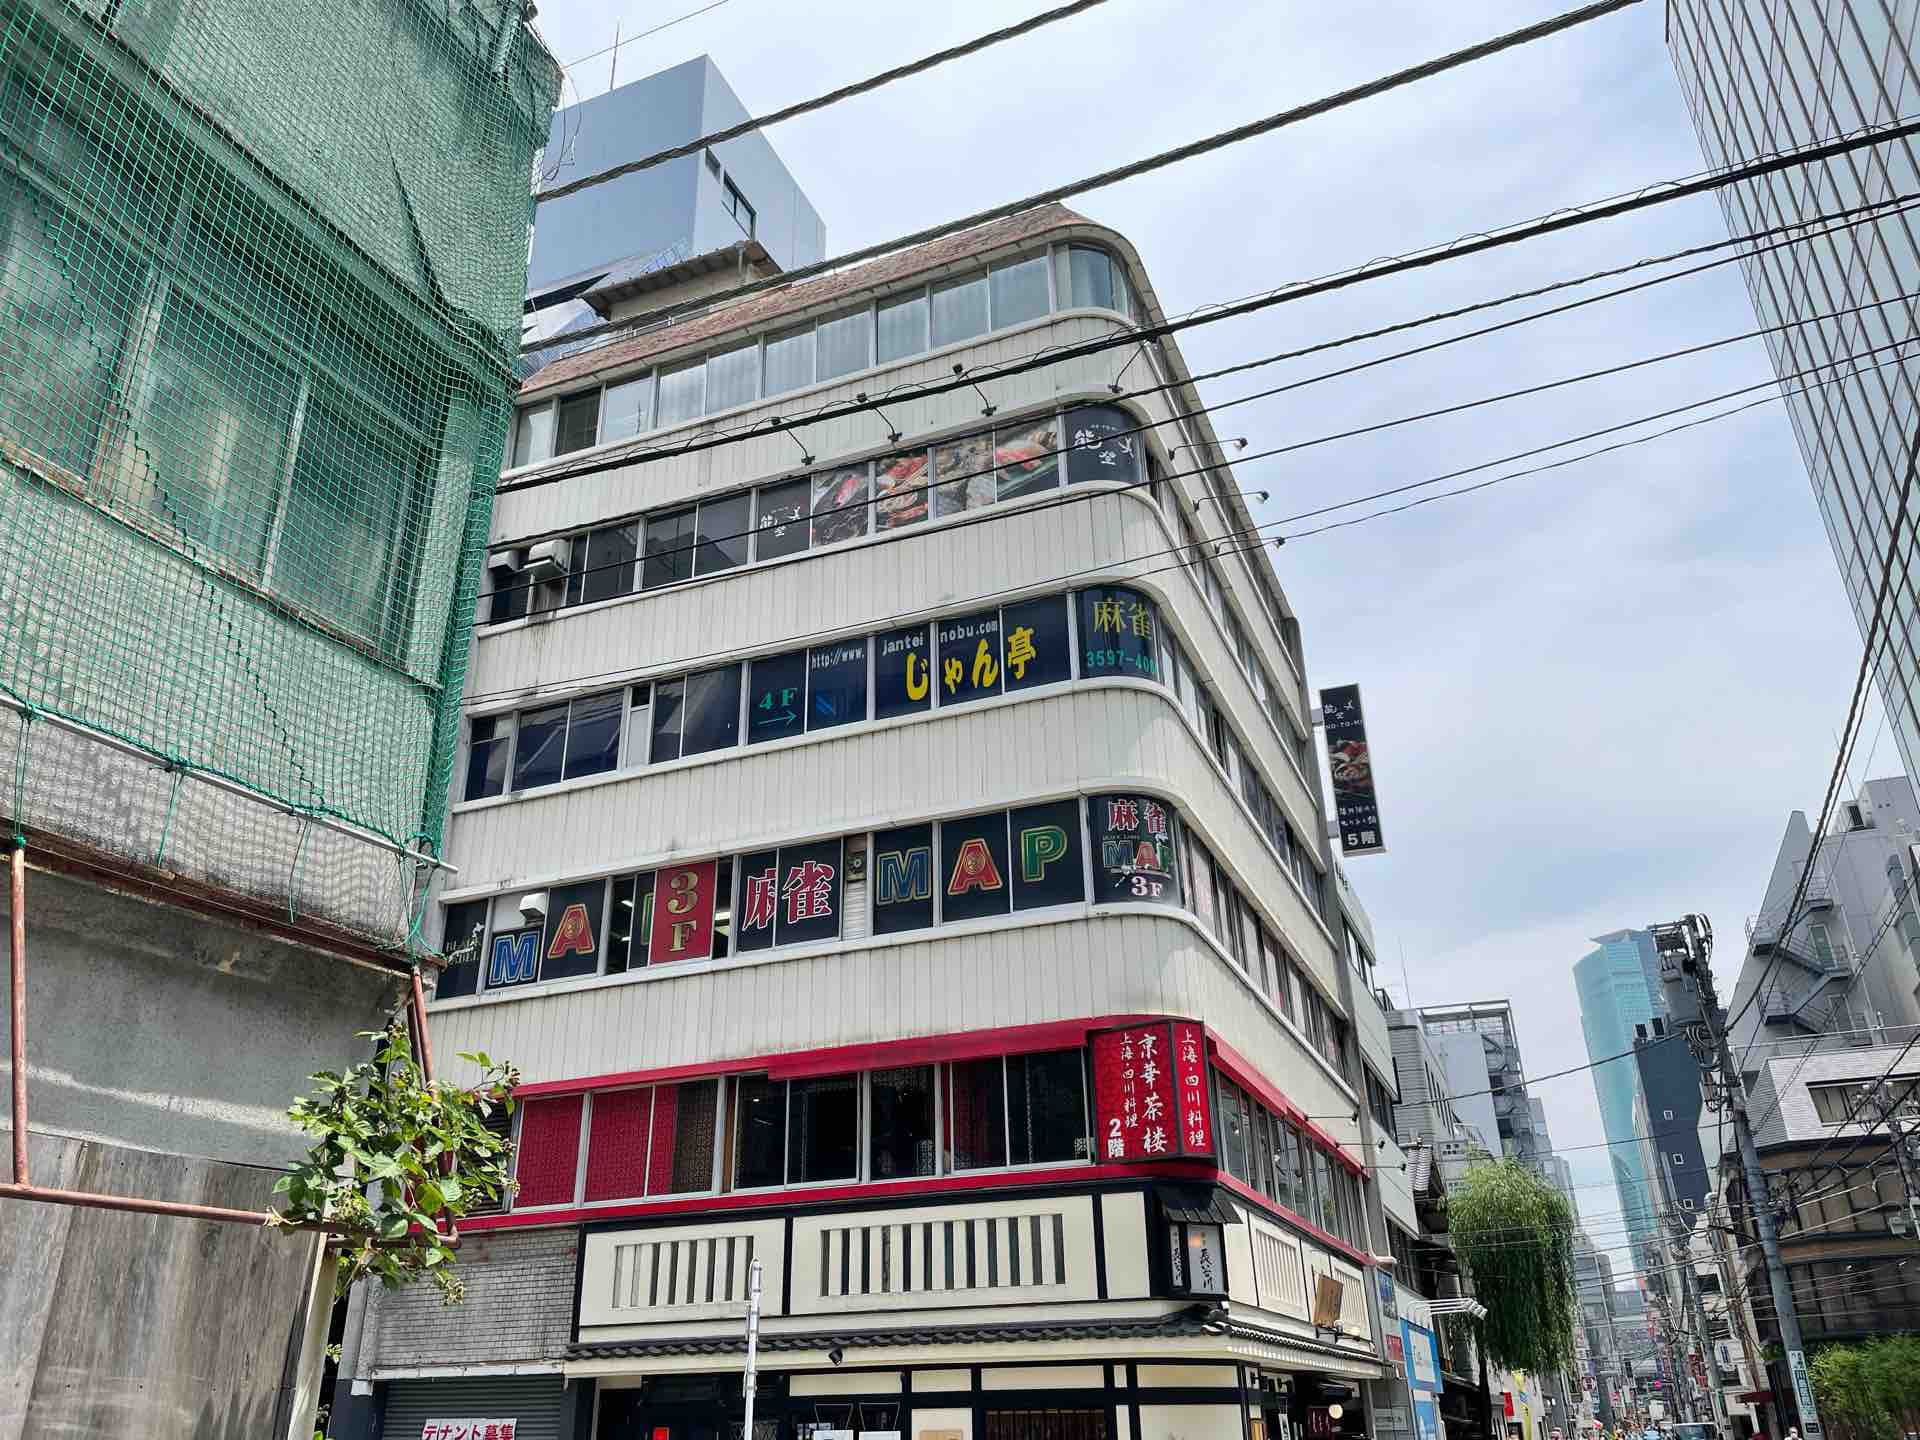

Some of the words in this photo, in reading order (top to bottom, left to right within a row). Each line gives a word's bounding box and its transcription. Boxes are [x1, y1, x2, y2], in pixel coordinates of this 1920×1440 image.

[1093, 597, 1153, 641] 麻雀
[811, 647, 865, 670] http://www.
[906, 627, 1037, 701] じゃん亭
[1107, 799, 1168, 835] 麻雀
[1347, 831, 1376, 846] 5階
[876, 825, 1068, 906] MAP
[1131, 876, 1163, 897] 3F
[1137, 1034, 1168, 1154] 京華茶楼
[1107, 1118, 1125, 1158] 2階
[423, 1423, 513, 1440] テナント募集
